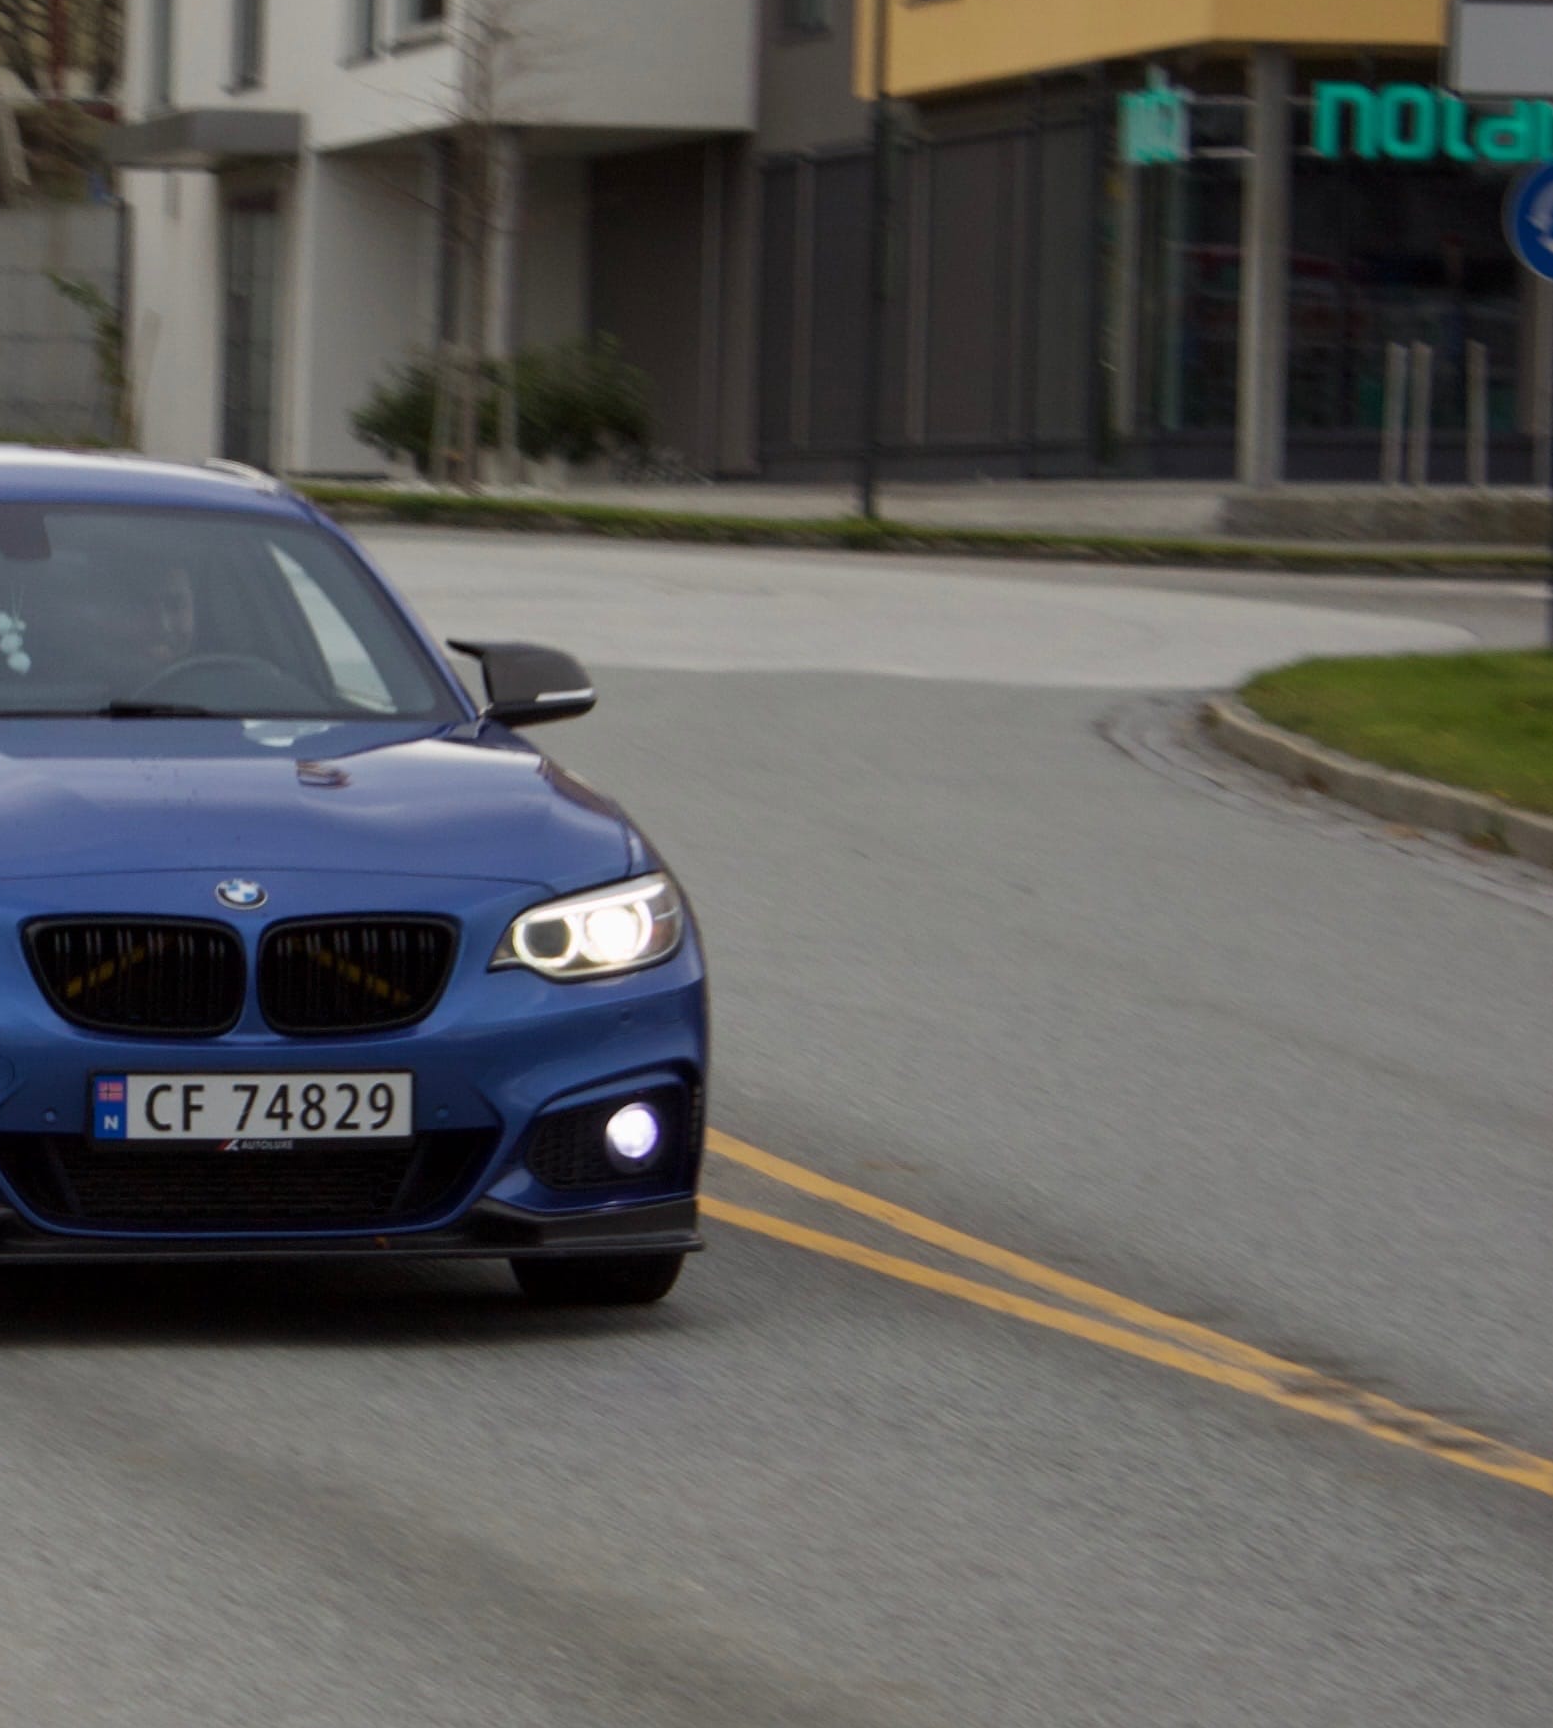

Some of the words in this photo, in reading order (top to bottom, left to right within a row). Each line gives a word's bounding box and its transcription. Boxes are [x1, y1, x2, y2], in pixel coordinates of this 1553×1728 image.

[104, 1115, 119, 1131] N
[145, 1084, 204, 1131] CF
[233, 1083, 394, 1131] 74829
